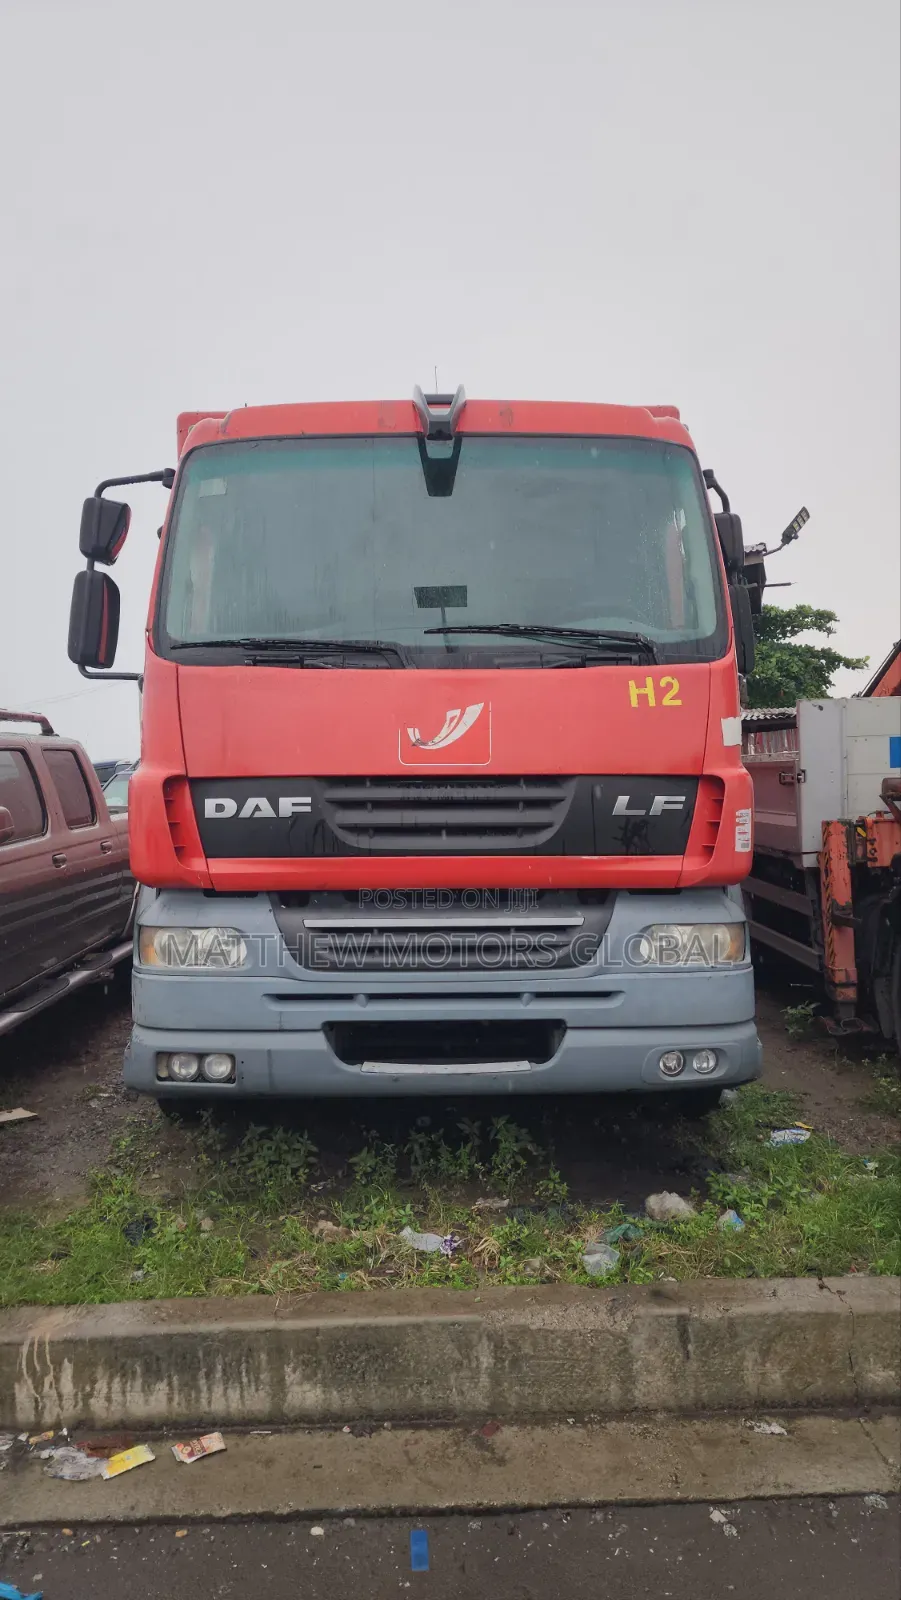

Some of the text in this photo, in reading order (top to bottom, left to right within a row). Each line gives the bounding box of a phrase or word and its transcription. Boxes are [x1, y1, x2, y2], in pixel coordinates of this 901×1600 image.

[628, 676, 682, 708] H2
[204, 796, 312, 818] DAF
[612, 795, 686, 816] LF
